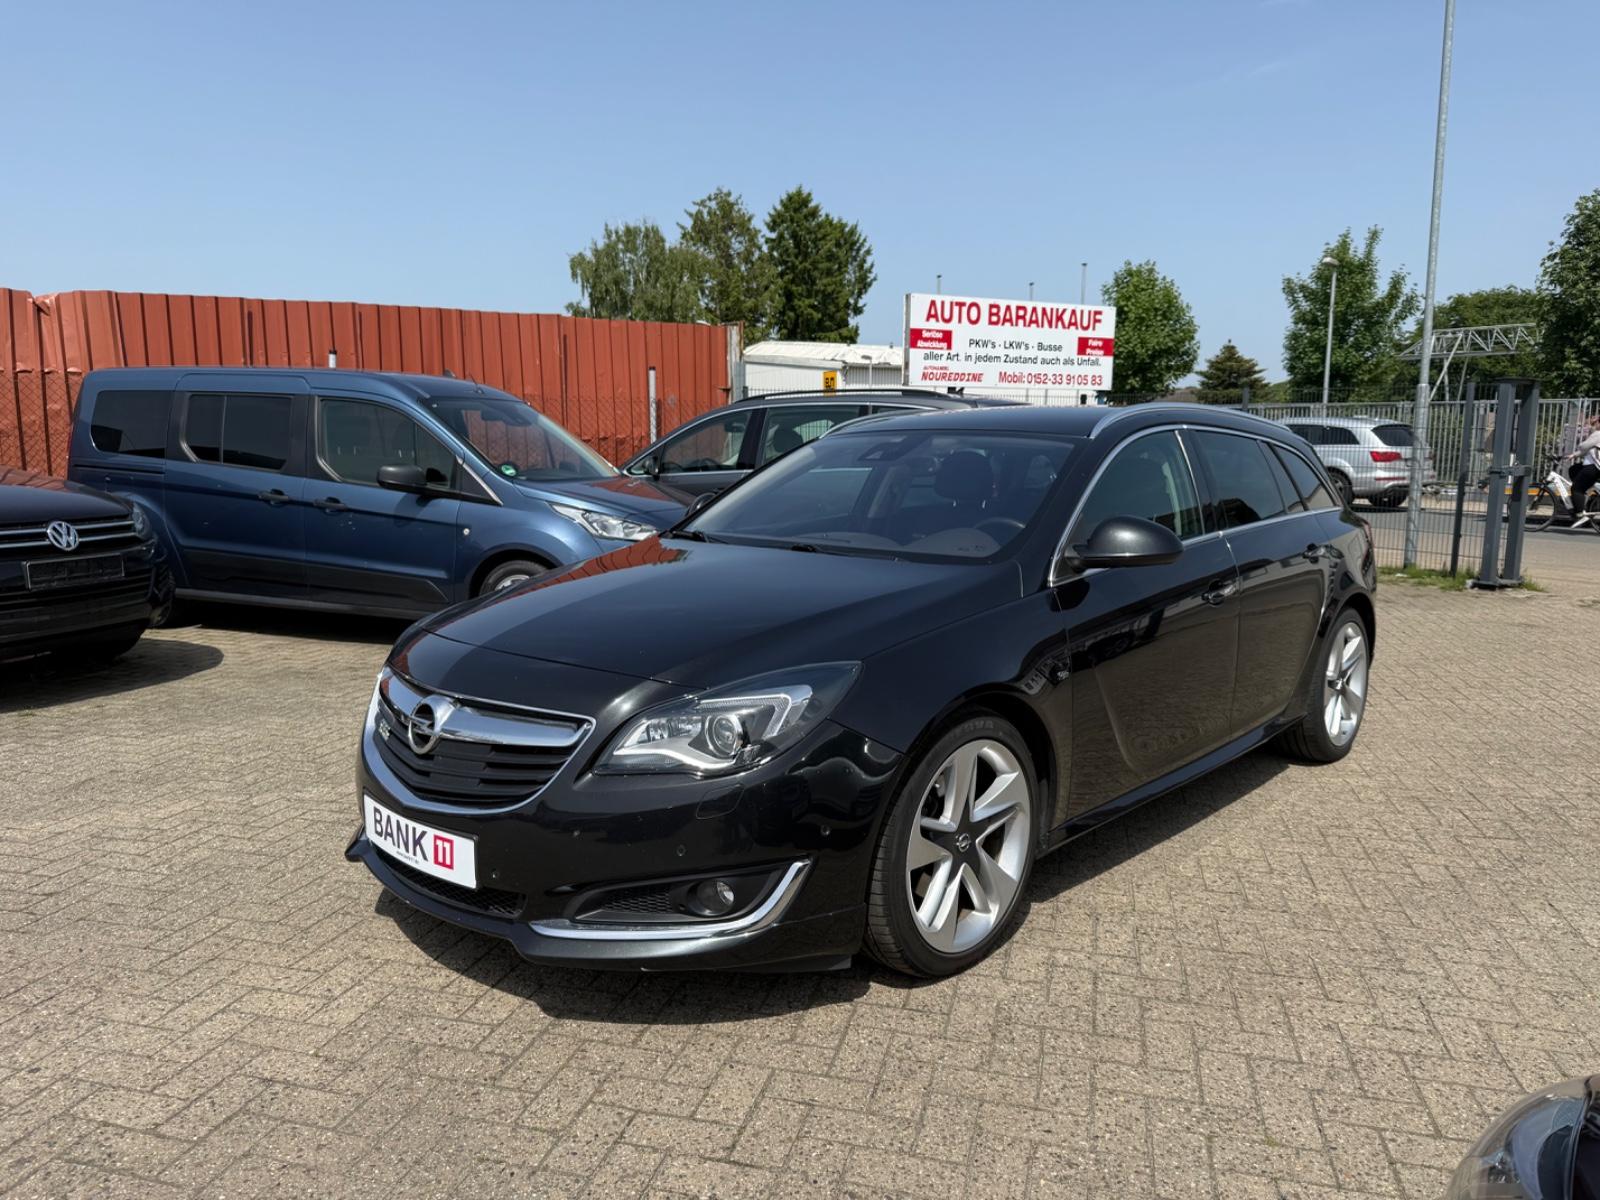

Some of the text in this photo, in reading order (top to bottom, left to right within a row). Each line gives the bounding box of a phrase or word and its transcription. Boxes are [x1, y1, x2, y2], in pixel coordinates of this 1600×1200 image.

[926, 299, 1103, 331] AUTO BARANKAUF
[968, 338, 1063, 352] PKW's LKW's Busse
[923, 352, 943, 361] aller
[964, 352, 973, 362] in
[974, 353, 1001, 364] jedem
[1003, 354, 1038, 365] Zustand
[1040, 355, 1060, 366] auch
[1062, 356, 1075, 366] als
[921, 371, 984, 383] NOUREDDINE
[998, 371, 1026, 384] Mobil:
[1091, 375, 1103, 386] 83
[373, 805, 429, 862] BANK
